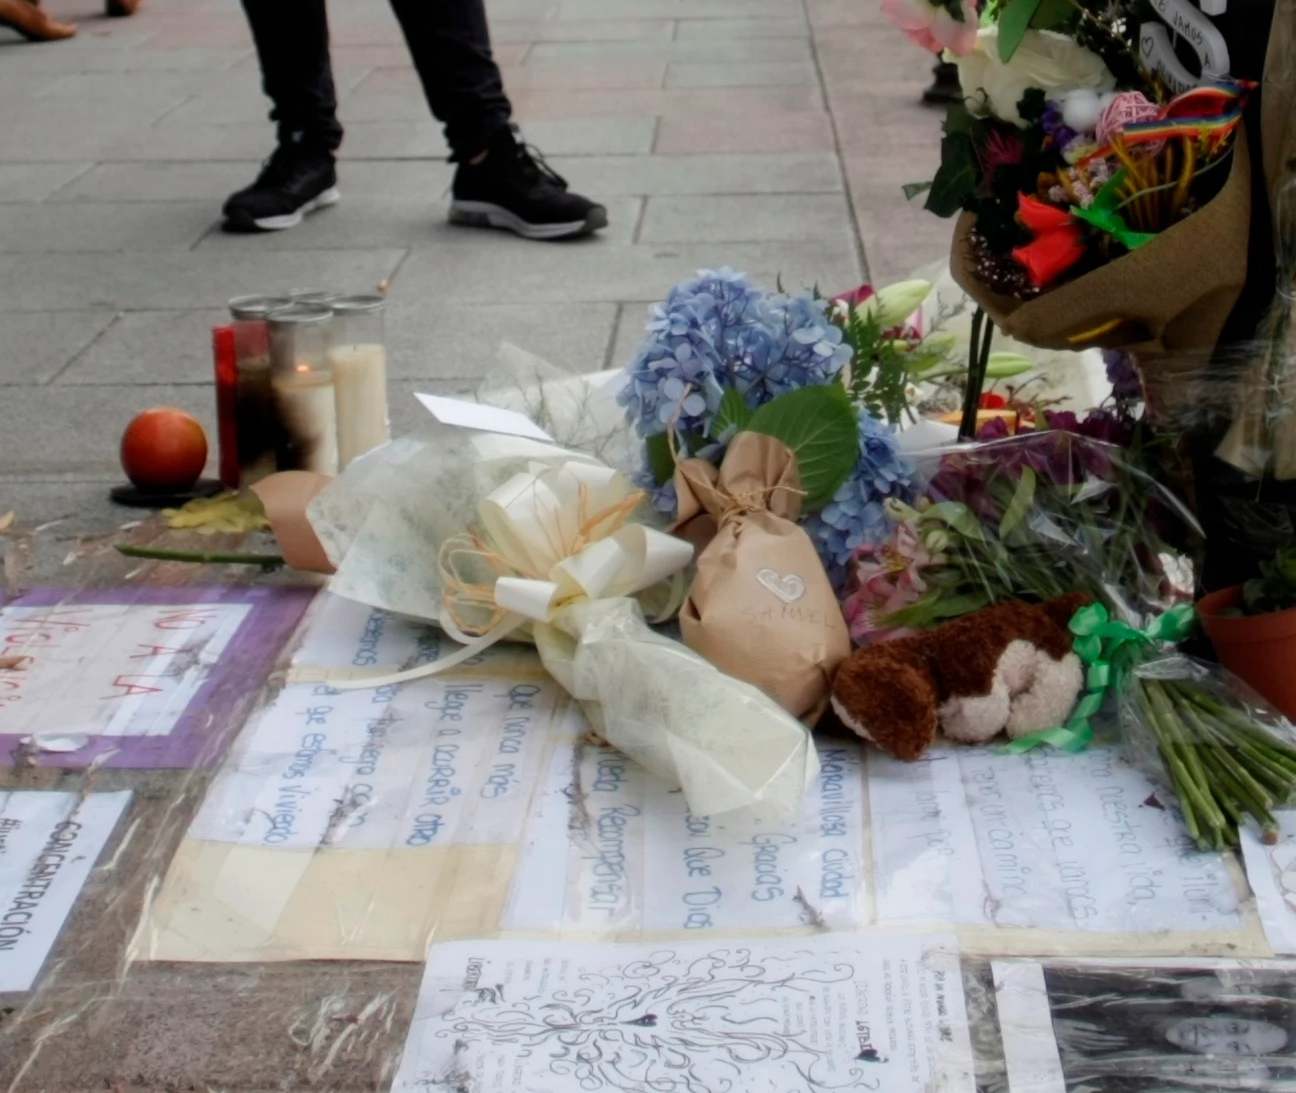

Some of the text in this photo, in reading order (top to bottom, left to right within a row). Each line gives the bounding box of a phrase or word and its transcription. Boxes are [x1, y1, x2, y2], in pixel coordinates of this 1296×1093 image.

[1172, 10, 1203, 46] VAMOS
[1204, 52, 1212, 69] A
[100, 610, 219, 698] NO A LA
[489, 764, 516, 796] más
